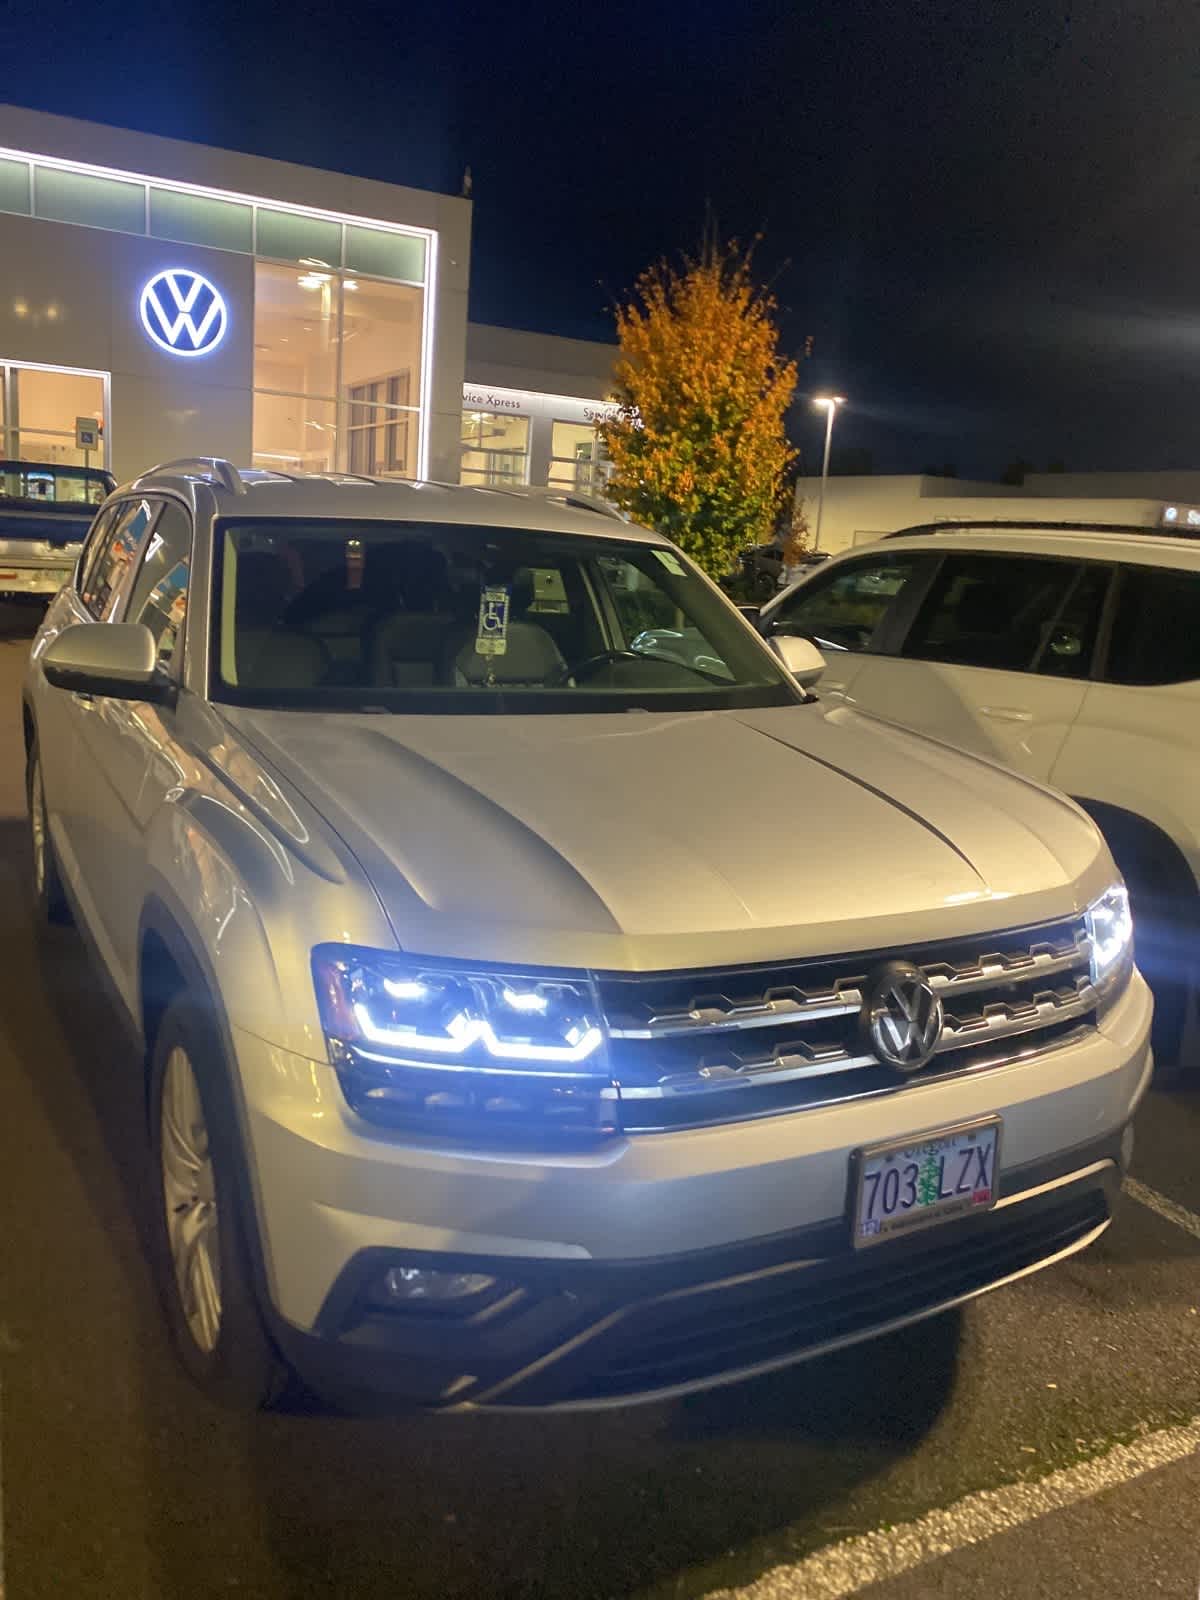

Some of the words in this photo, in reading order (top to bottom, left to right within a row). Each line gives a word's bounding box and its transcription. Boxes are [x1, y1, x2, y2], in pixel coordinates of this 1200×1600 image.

[143, 270, 225, 352] VW
[486, 394, 521, 408] Xpress
[864, 1162, 919, 1220] 703
[938, 1143, 991, 1200] LZX
